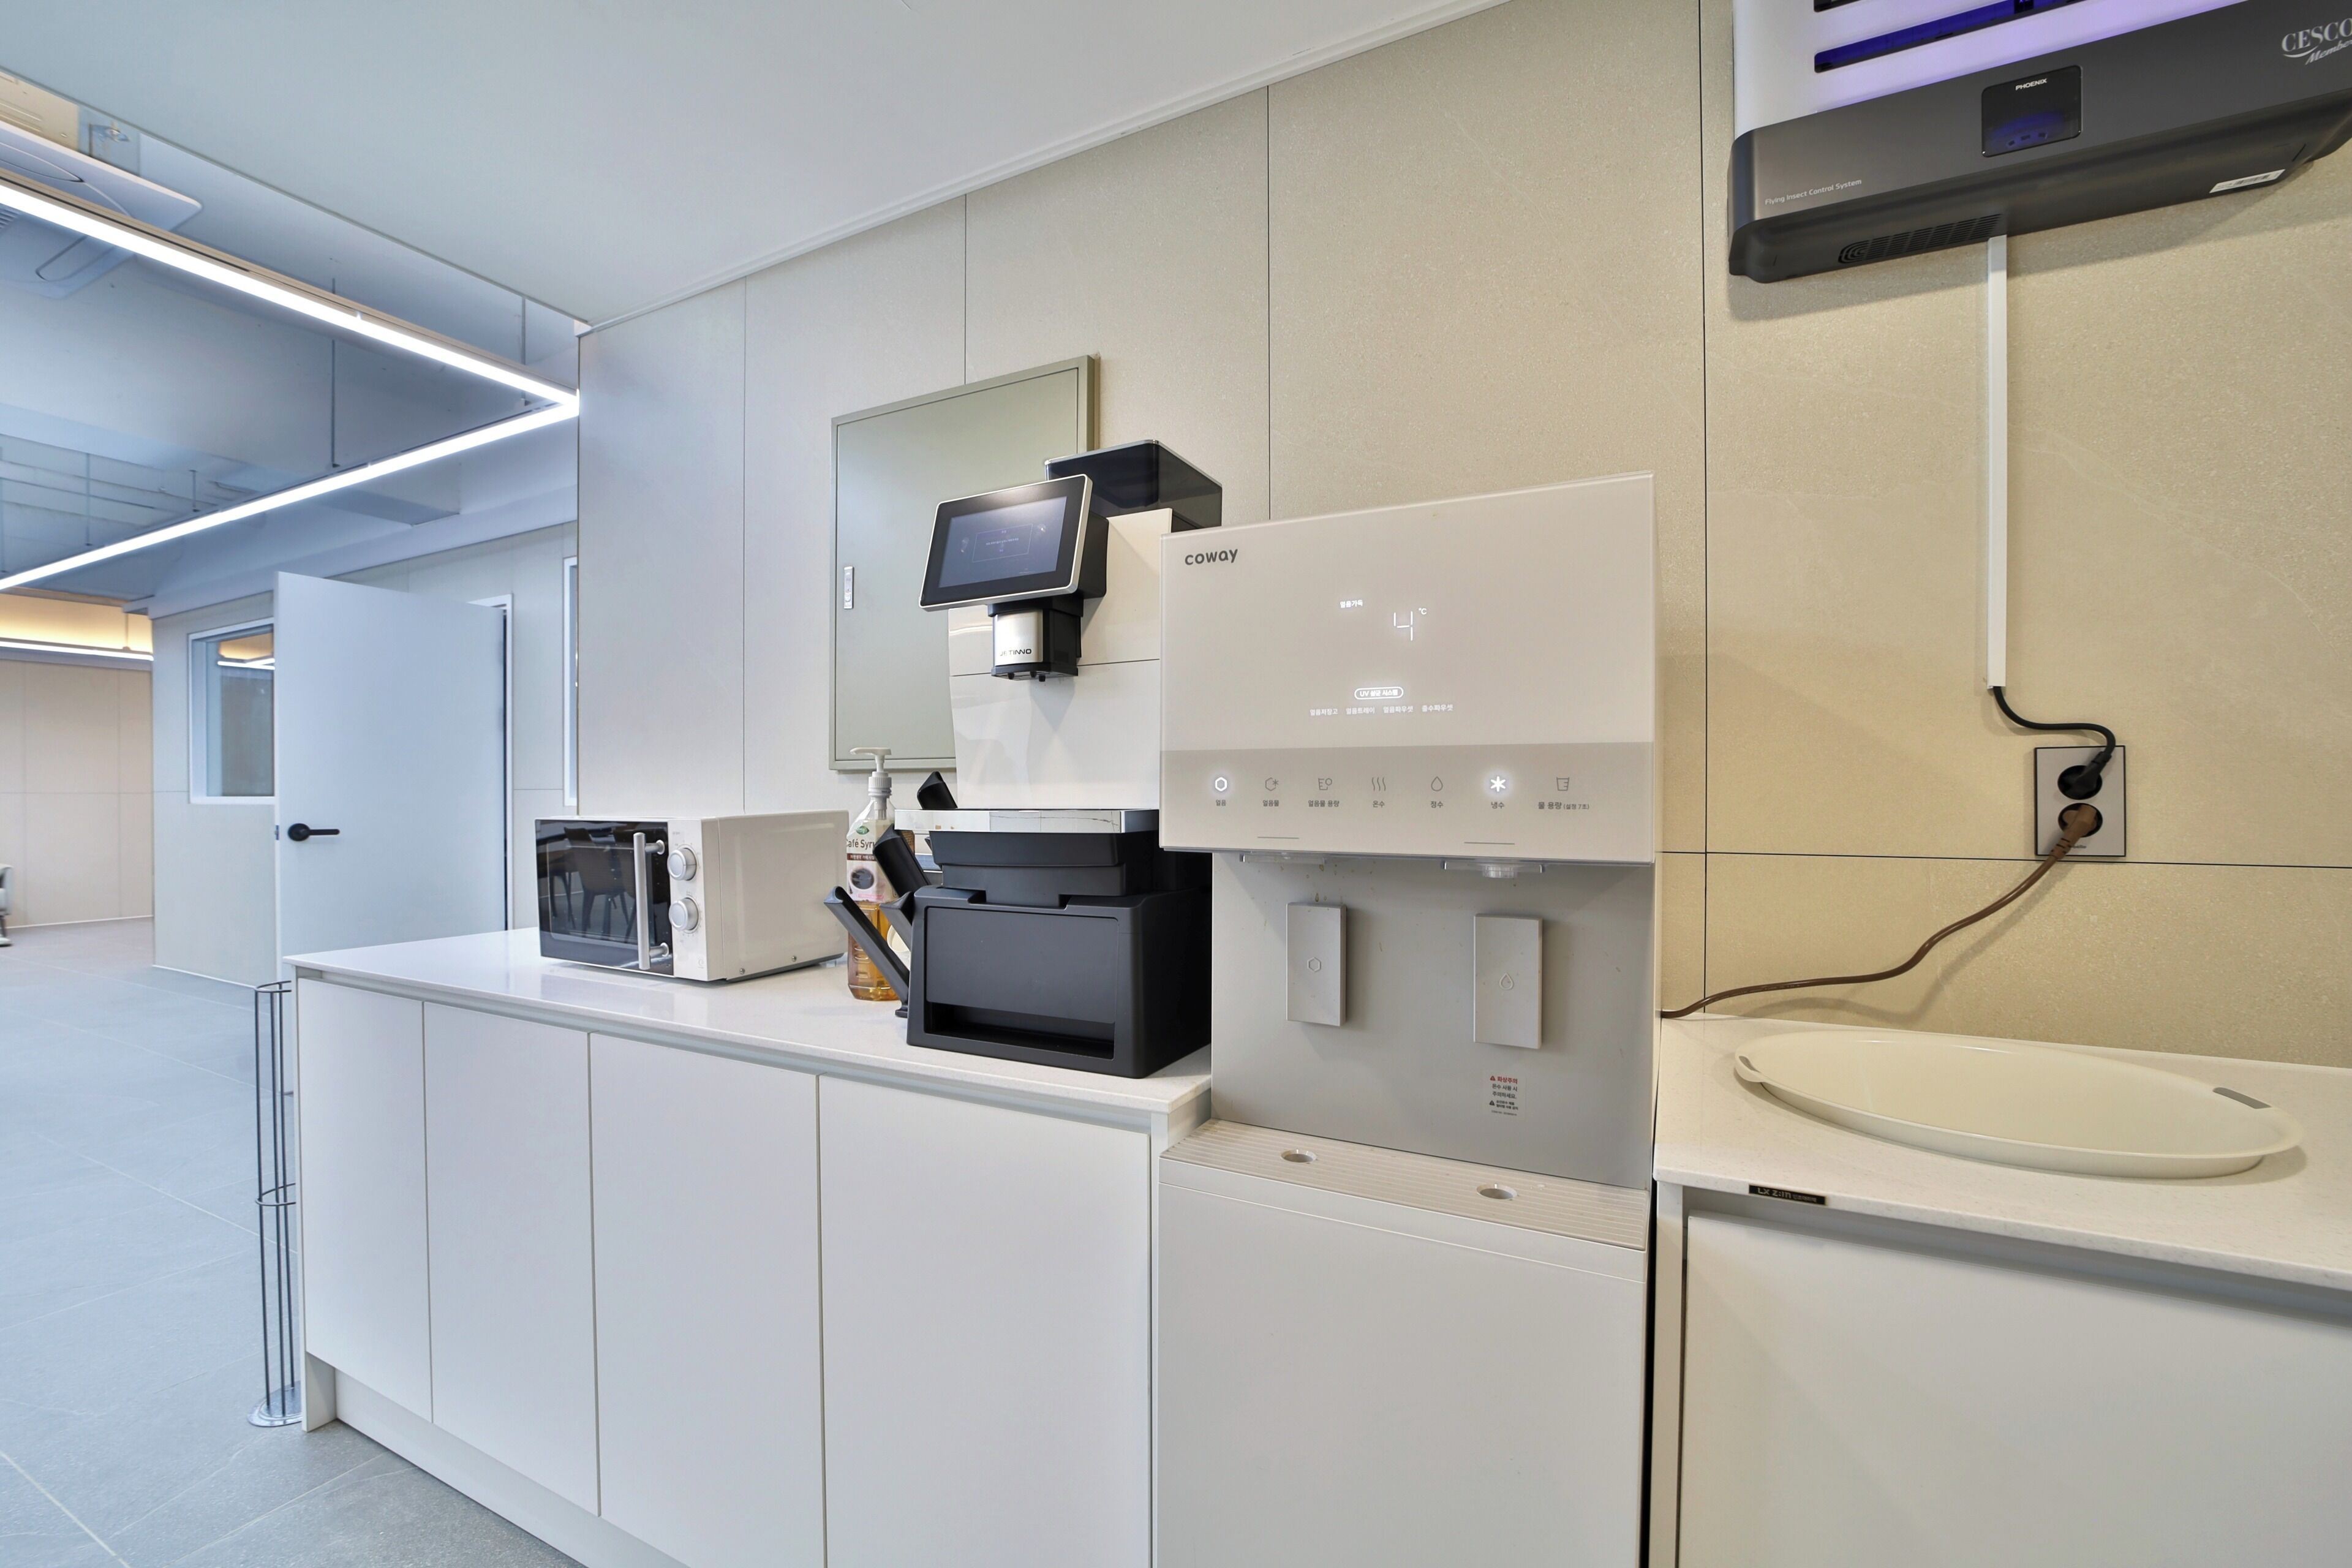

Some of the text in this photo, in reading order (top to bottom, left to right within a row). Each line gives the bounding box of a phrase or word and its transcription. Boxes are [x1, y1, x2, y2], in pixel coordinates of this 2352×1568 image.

[2282, 18, 2352, 52] CESCO
[2015, 78, 2048, 91] PHOENIX
[1765, 179, 1862, 205] Flying Insect Control System
[1185, 549, 1238, 565] coway
[1393, 611, 1413, 641] 4
[1547, 801, 1562, 810] 용량
[846, 839, 859, 848] afé
